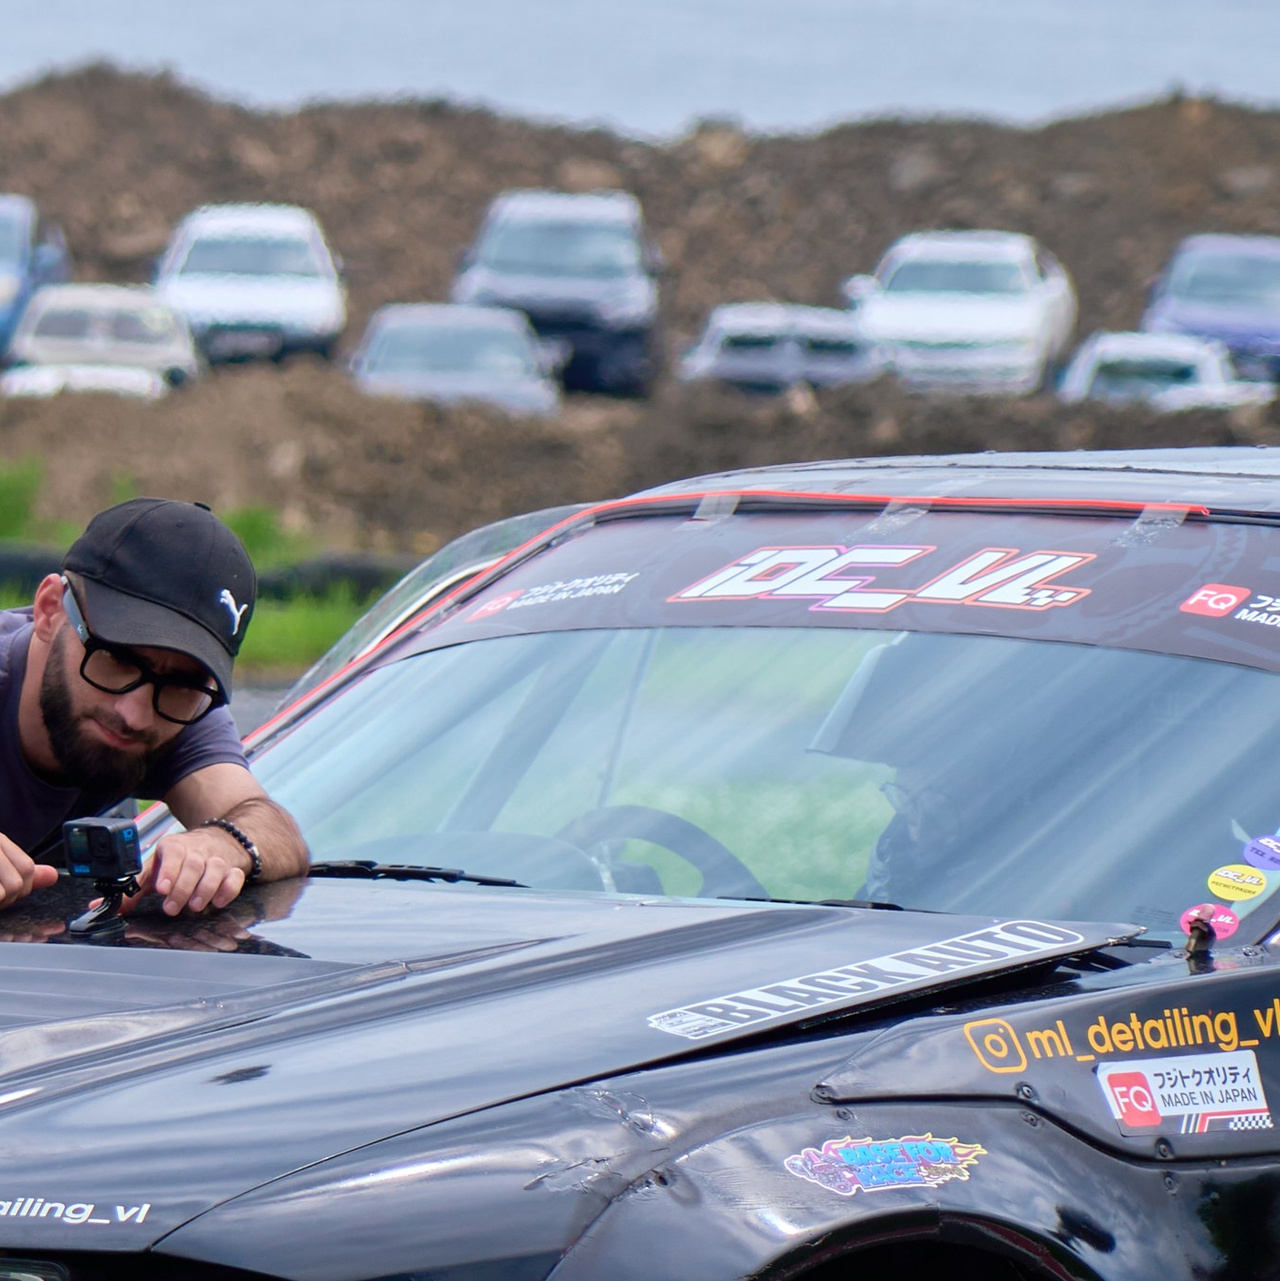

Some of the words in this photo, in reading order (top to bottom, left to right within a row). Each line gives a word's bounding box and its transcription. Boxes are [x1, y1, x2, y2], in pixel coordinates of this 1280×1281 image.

[1188, 589, 1237, 610] FQ
[685, 963, 894, 1024] BLACK
[891, 920, 1081, 979] AUTO
[1153, 1066, 1251, 1090] フジトクオリティ
[1114, 1086, 1155, 1114] FQ
[1161, 1092, 1200, 1108] MADE
[1201, 1091, 1216, 1105] IN
[1218, 1087, 1258, 1104] JAPAN
[838, 1142, 905, 1166] BASE
[905, 1141, 958, 1164] FOR
[857, 1163, 923, 1187] RACE
